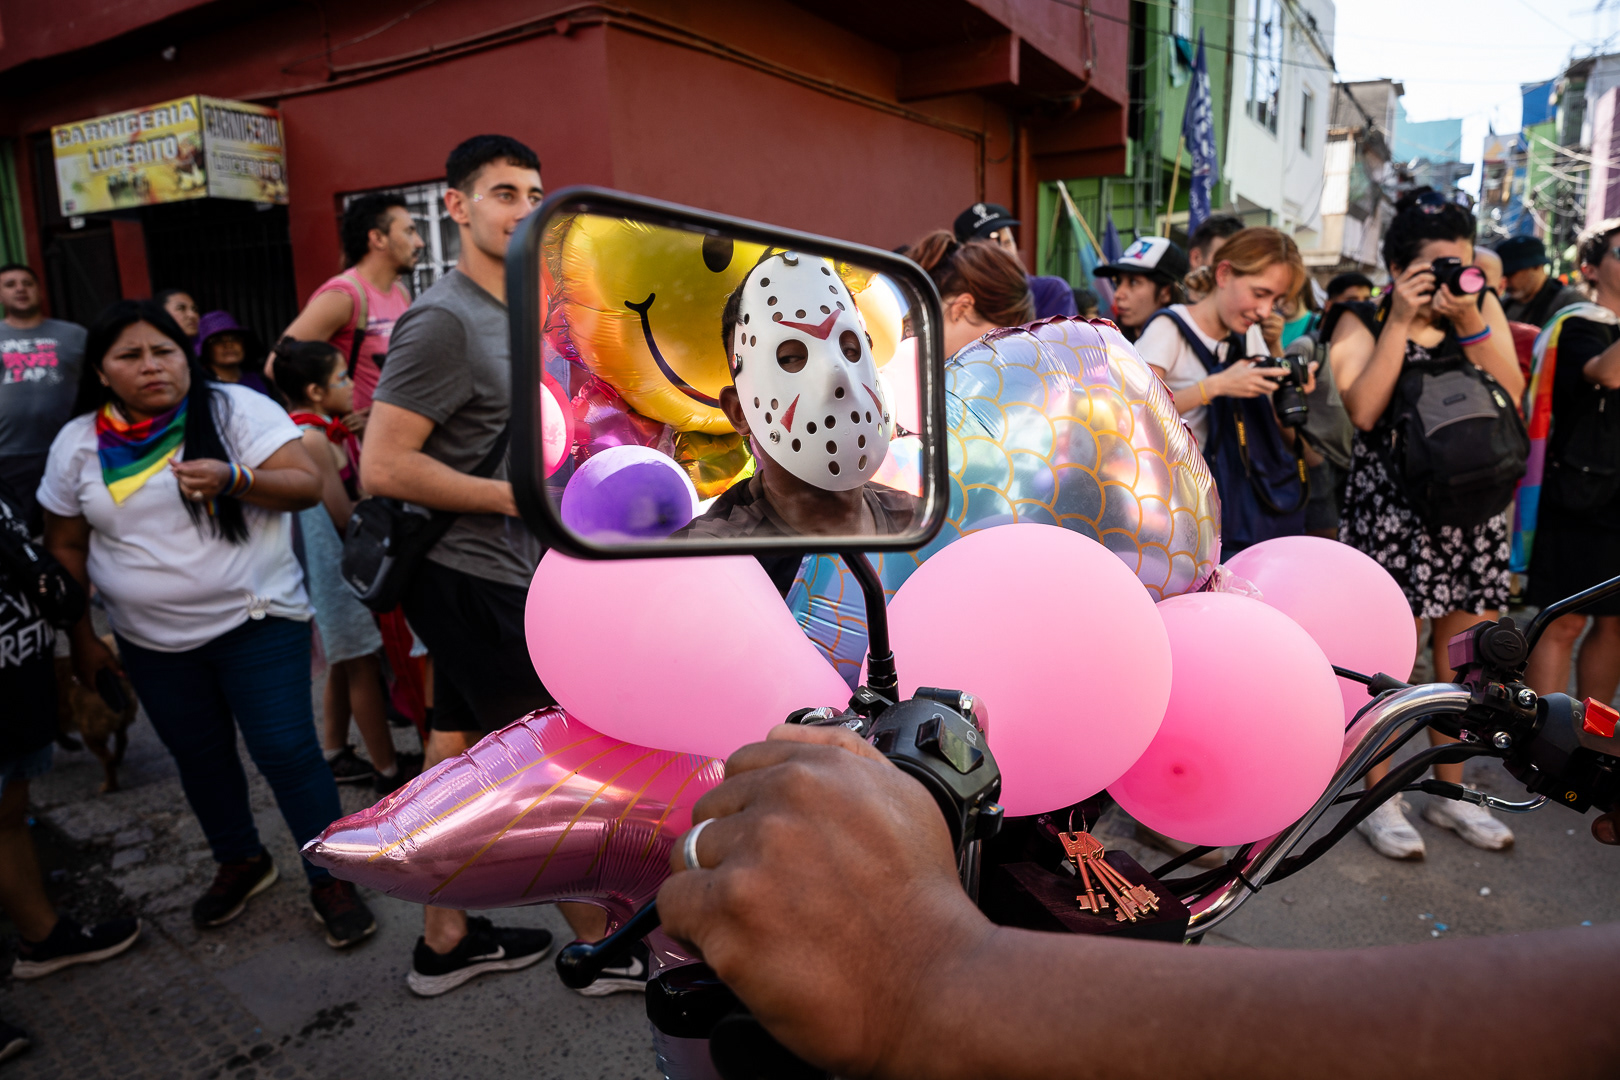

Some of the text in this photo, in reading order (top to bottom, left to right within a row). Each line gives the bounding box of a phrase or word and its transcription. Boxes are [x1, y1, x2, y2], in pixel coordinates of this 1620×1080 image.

[54, 102, 196, 148] CARNICERIA
[87, 134, 179, 173] LUCERITO
[214, 155, 281, 180] LUCERITO
